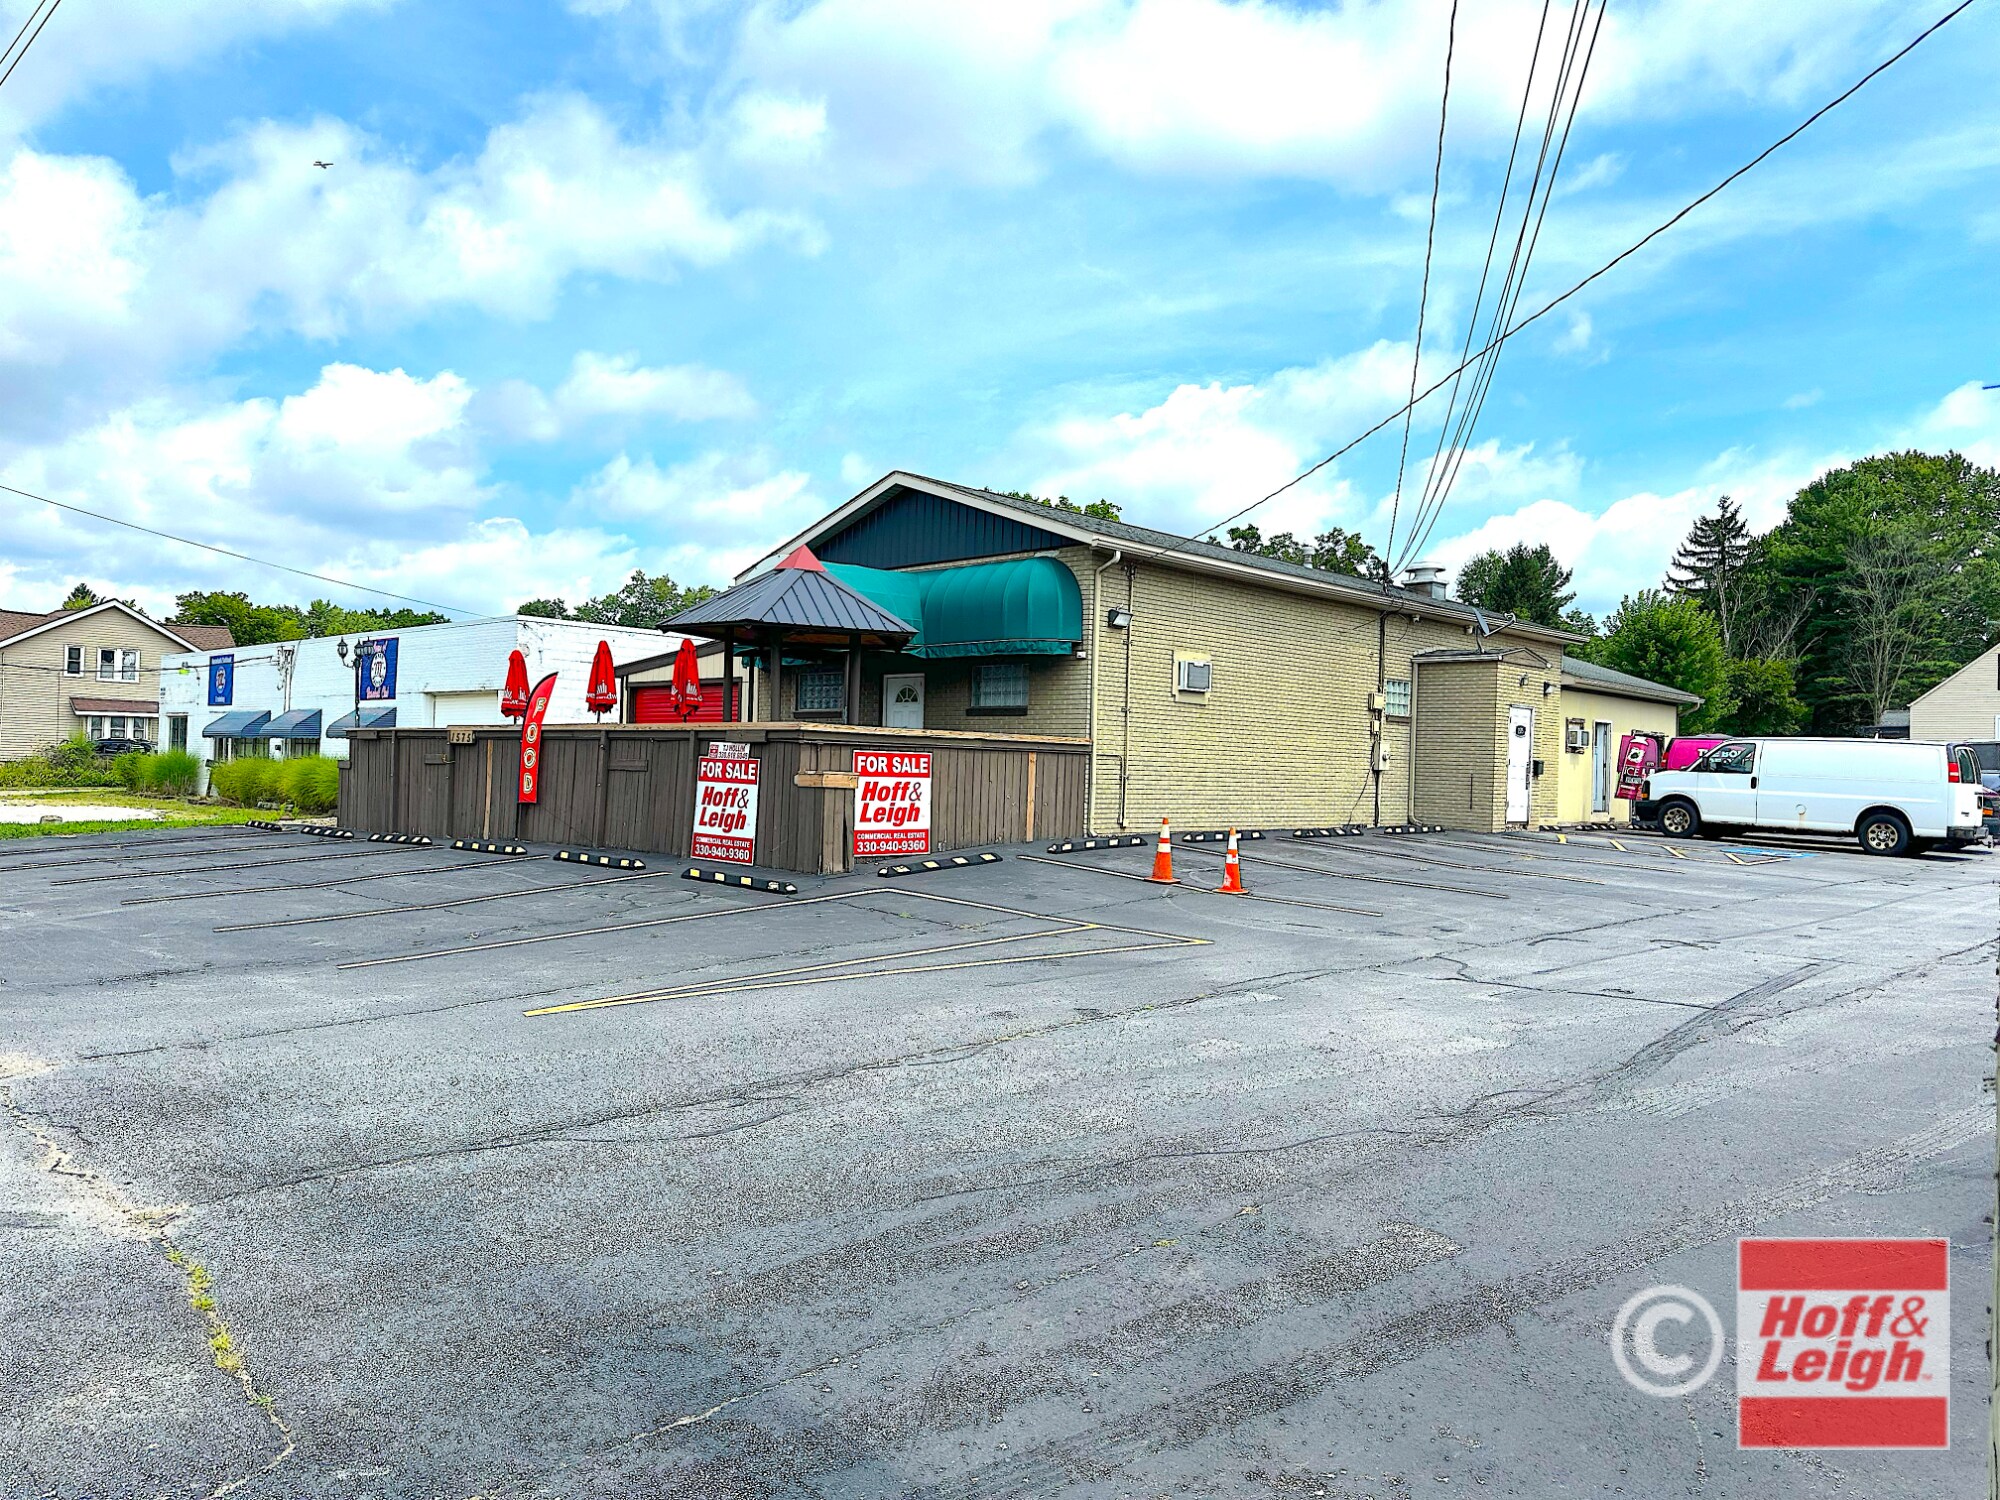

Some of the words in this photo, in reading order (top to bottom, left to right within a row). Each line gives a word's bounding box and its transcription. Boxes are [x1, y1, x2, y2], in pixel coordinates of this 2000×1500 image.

[451, 732, 472, 743] 1575
[523, 697, 546, 794] FOOD
[700, 761, 723, 778] FOR
[725, 762, 757, 781] SALE
[857, 755, 889, 773] FOR
[892, 756, 929, 774] SALE
[701, 785, 750, 809] Hoff&
[861, 781, 923, 802] Hoff&
[698, 806, 747, 834] Leigh
[859, 802, 921, 827] Leigh
[733, 840, 751, 848] ESTATE
[856, 832, 893, 840] COMMERCIAL
[907, 831, 926, 839] ESTATE
[694, 844, 750, 860] 330-940-9360
[857, 840, 926, 852] 330-940-9360
